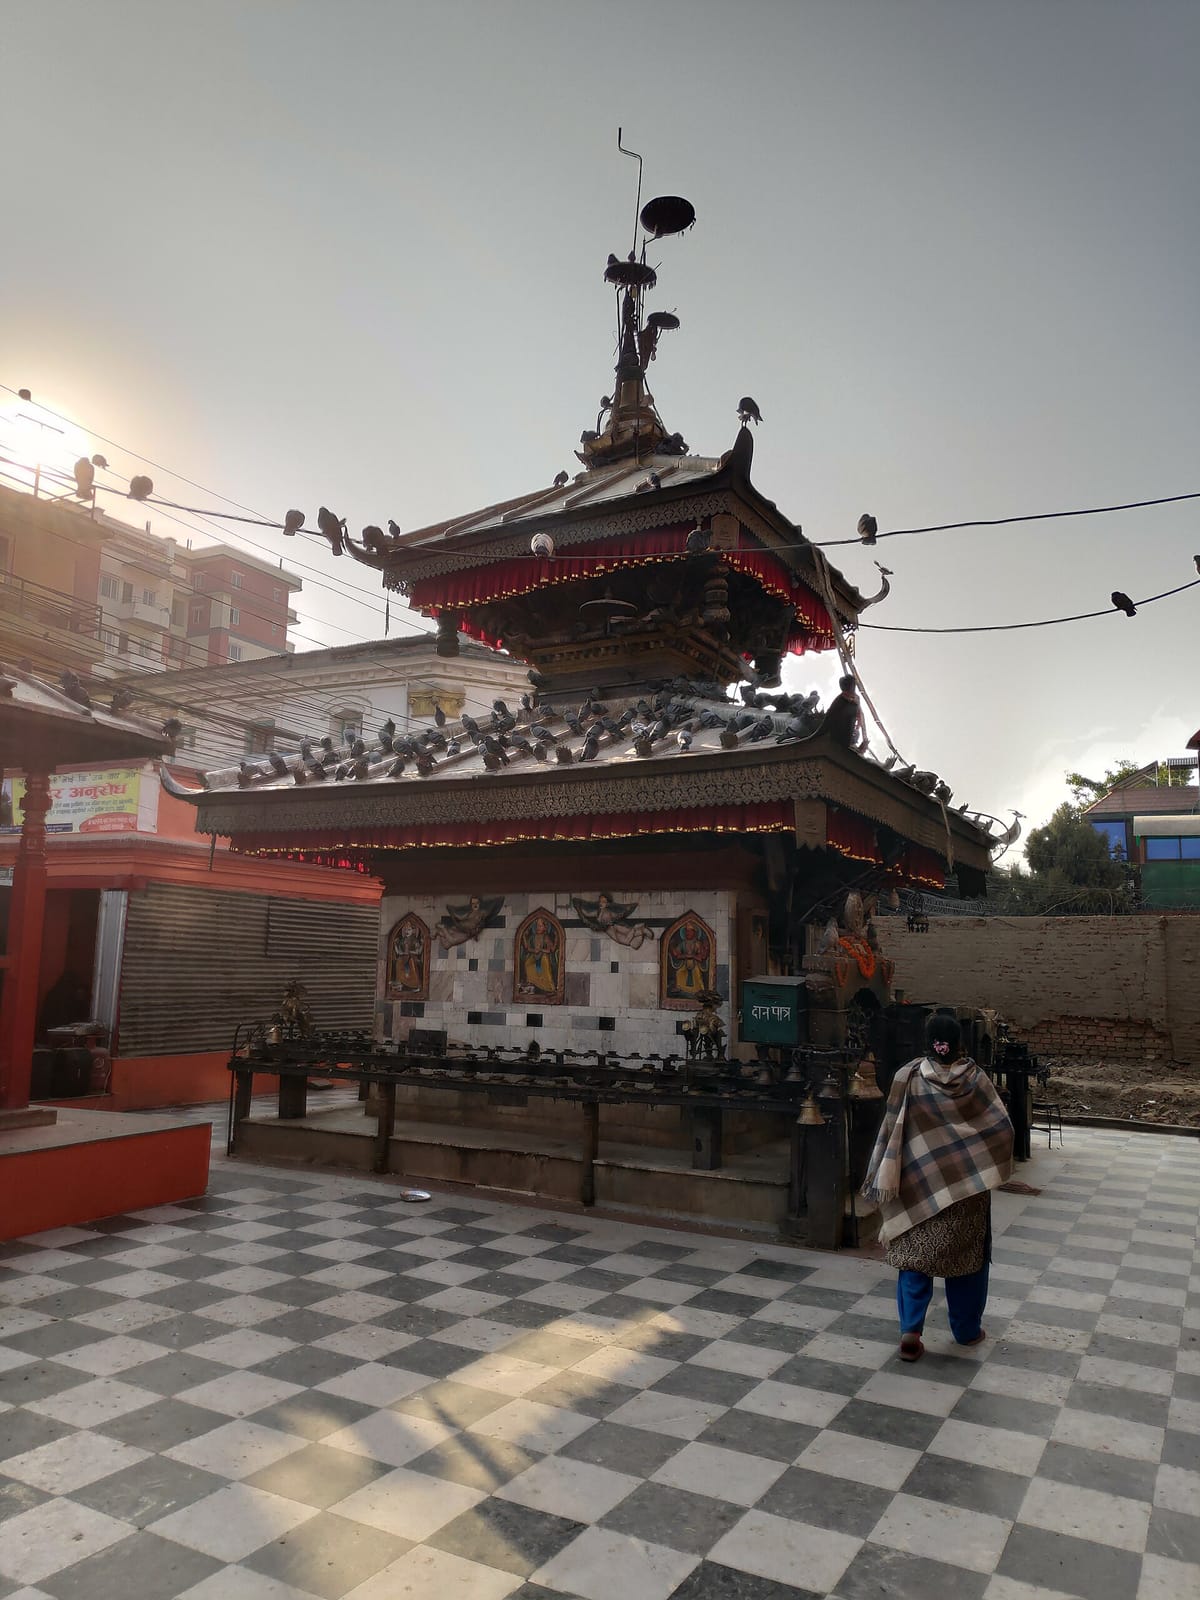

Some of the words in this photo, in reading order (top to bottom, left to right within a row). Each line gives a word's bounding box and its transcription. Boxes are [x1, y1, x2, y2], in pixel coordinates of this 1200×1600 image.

[69, 782, 127, 799] अनुरोध
[751, 1005, 770, 1021] दान
[771, 1006, 791, 1022] पात्र
